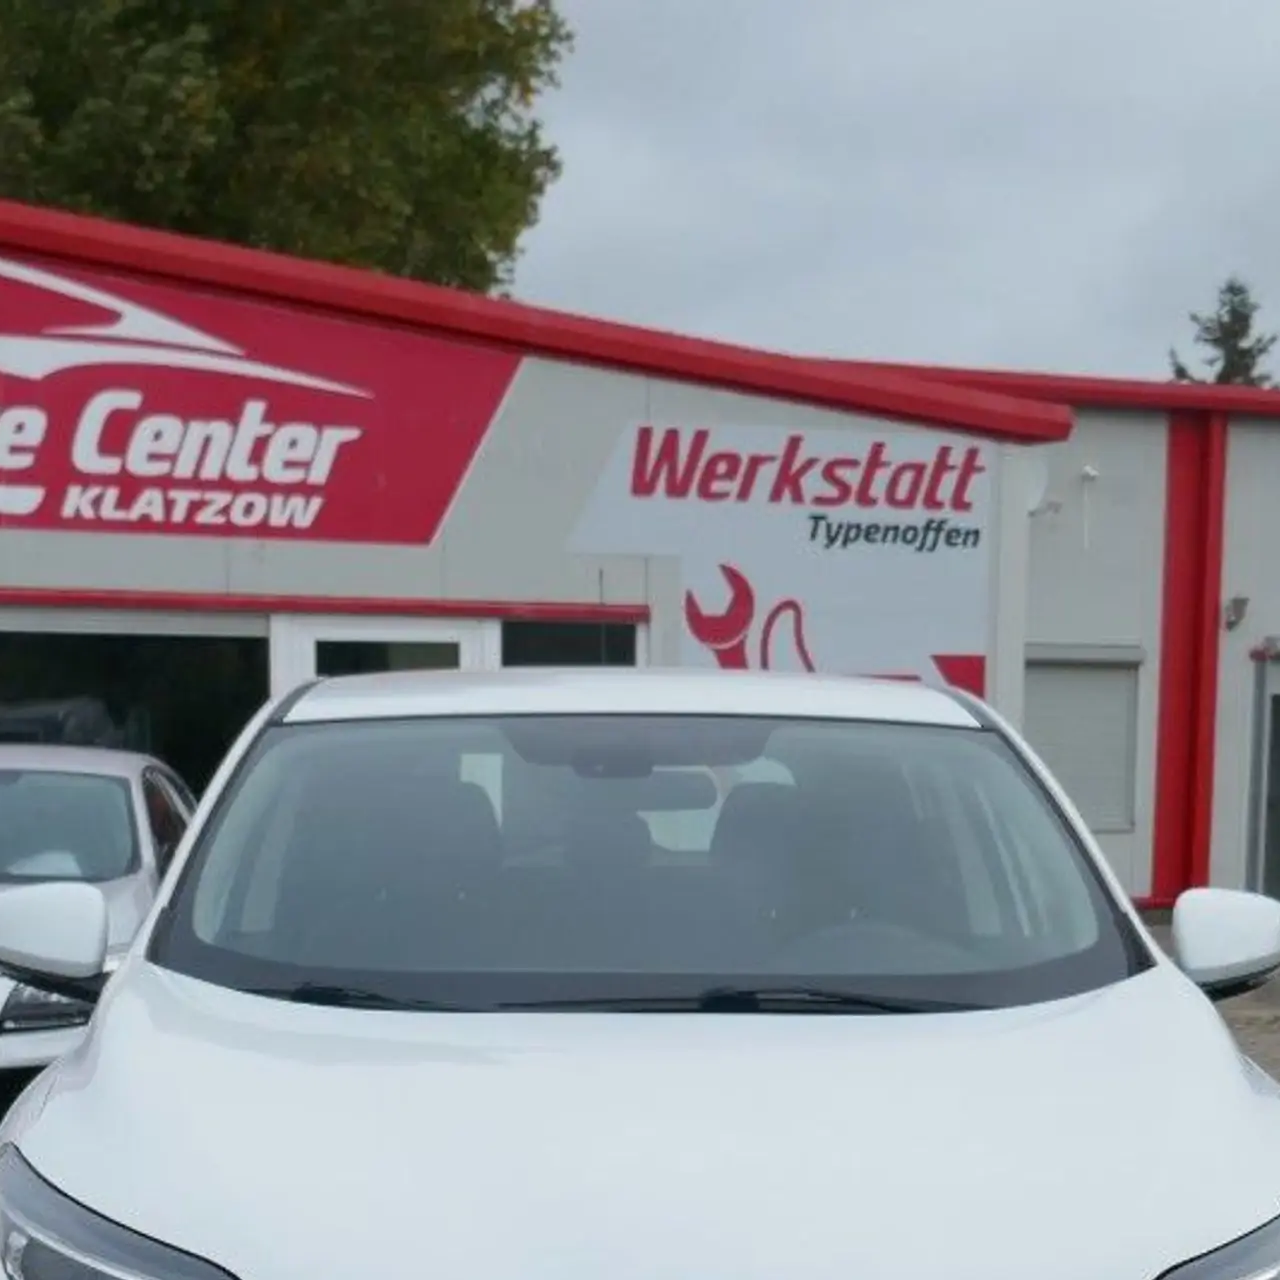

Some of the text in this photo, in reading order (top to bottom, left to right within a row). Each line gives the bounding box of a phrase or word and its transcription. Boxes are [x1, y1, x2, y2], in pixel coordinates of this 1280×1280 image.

[71, 389, 362, 485] Center
[630, 426, 987, 512] Werkstatt
[60, 485, 325, 529] KLATZOW
[807, 514, 982, 551] Typenoffen
